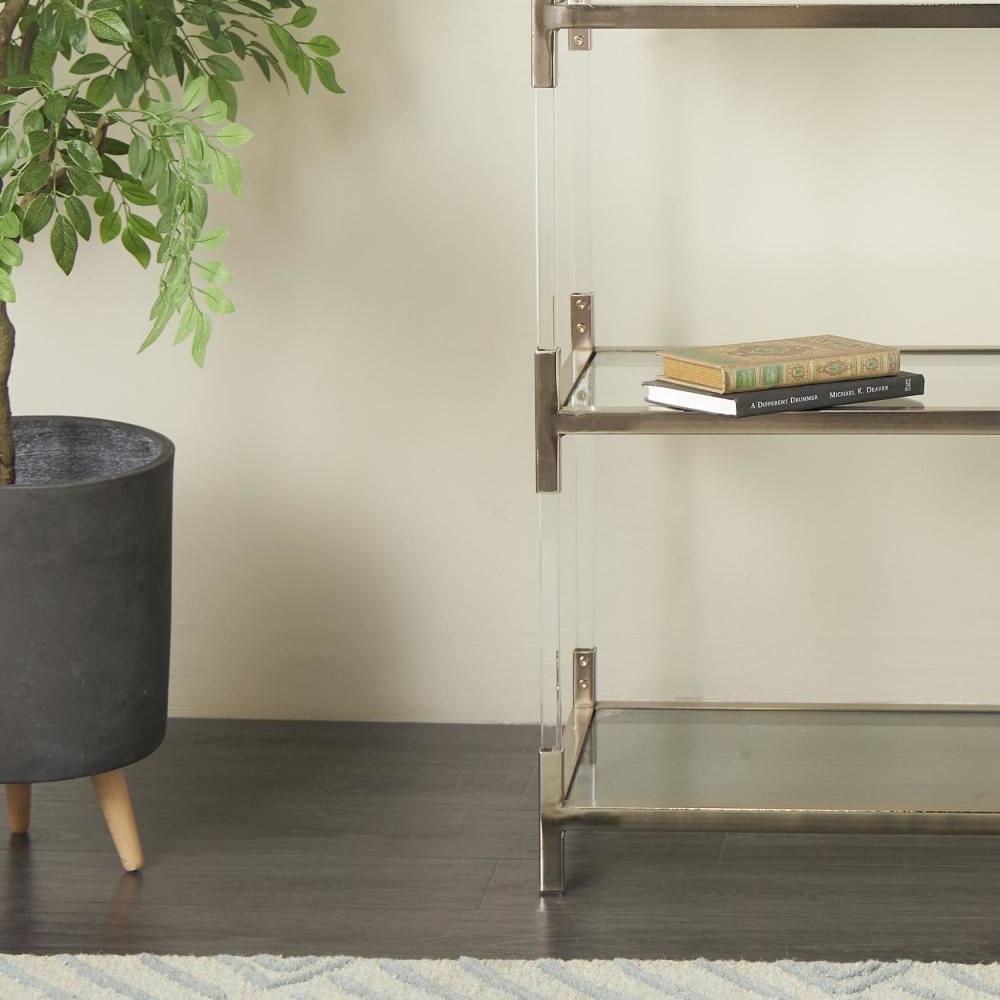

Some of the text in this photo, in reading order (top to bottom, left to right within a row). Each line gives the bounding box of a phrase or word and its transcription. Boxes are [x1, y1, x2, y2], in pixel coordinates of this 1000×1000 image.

[830, 390, 855, 398] MICHAEL
[867, 385, 888, 394] DEAVER
[758, 400, 788, 408] DIFFERENT
[790, 395, 818, 404] DRUMMER
